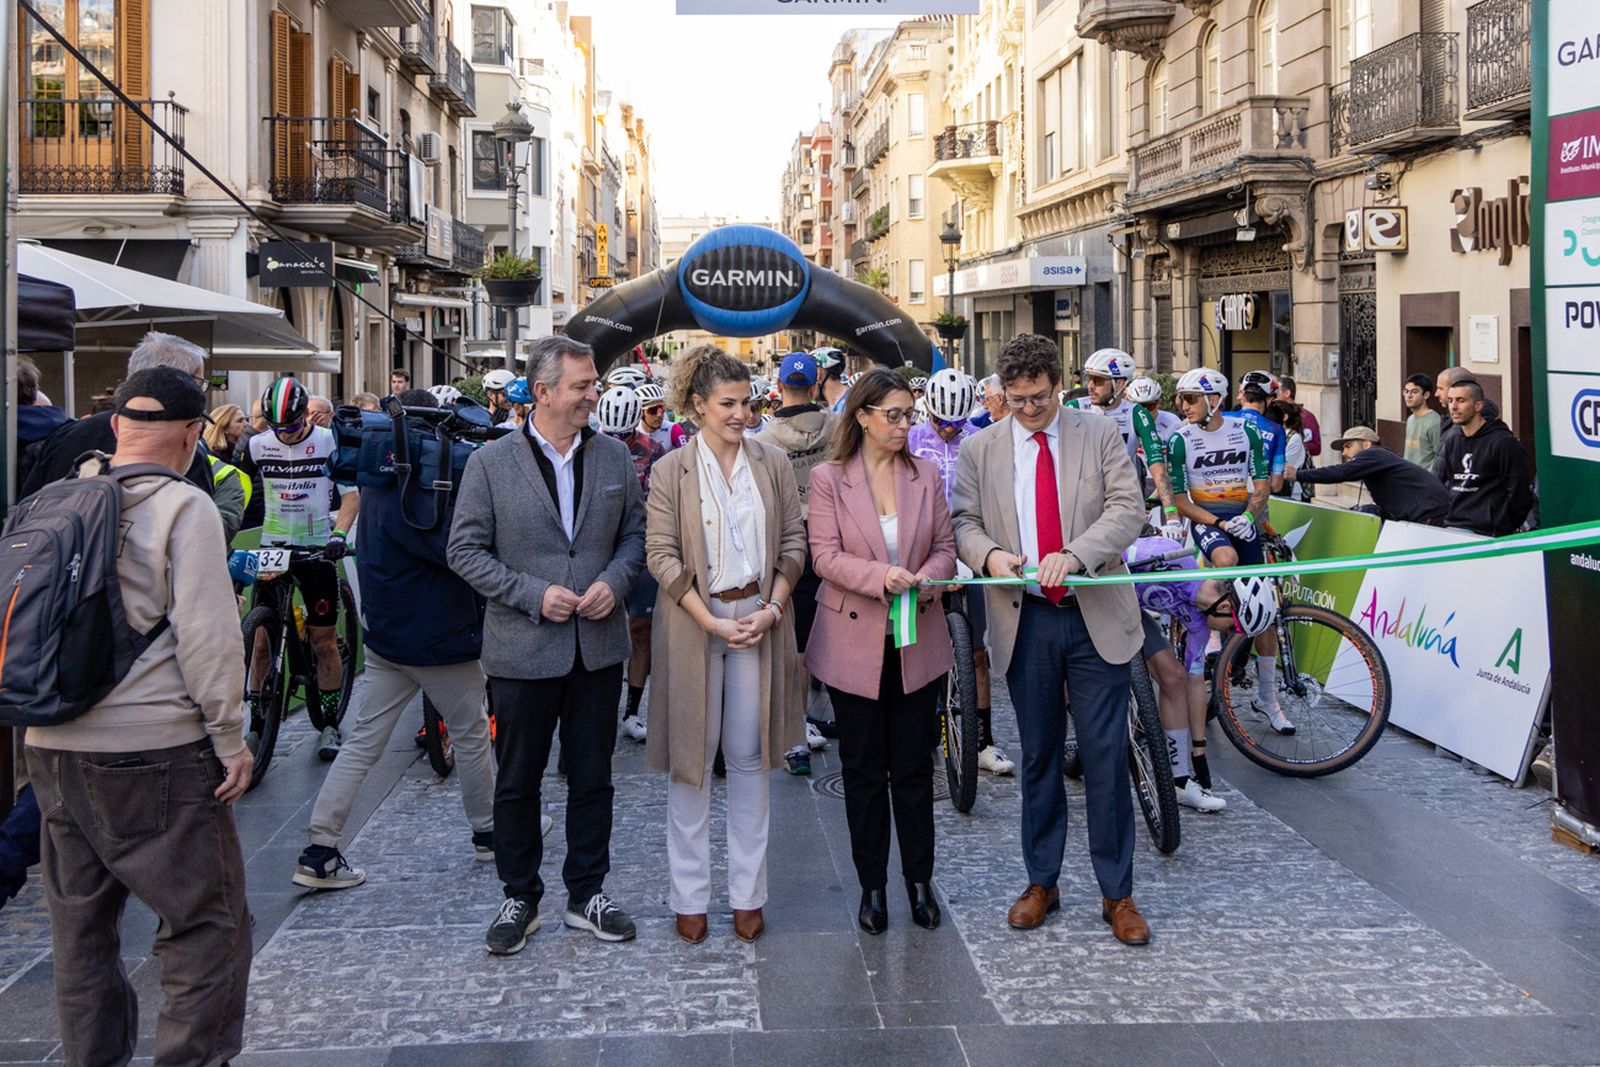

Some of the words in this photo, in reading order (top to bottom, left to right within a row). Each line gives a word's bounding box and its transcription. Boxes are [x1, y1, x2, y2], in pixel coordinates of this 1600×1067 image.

[691, 269, 798, 288] GARMIN
[1043, 266, 1073, 275] asisa
[584, 315, 633, 333] garmin.com
[1565, 300, 1600, 329] PO
[855, 318, 902, 336] garmin.com
[1193, 449, 1247, 469] KTM
[288, 481, 316, 490] italia
[1359, 586, 1460, 669] Andalucía
[1476, 668, 1493, 681] Junta
[1493, 673, 1501, 683] de
[1501, 676, 1531, 695] Andalucía
